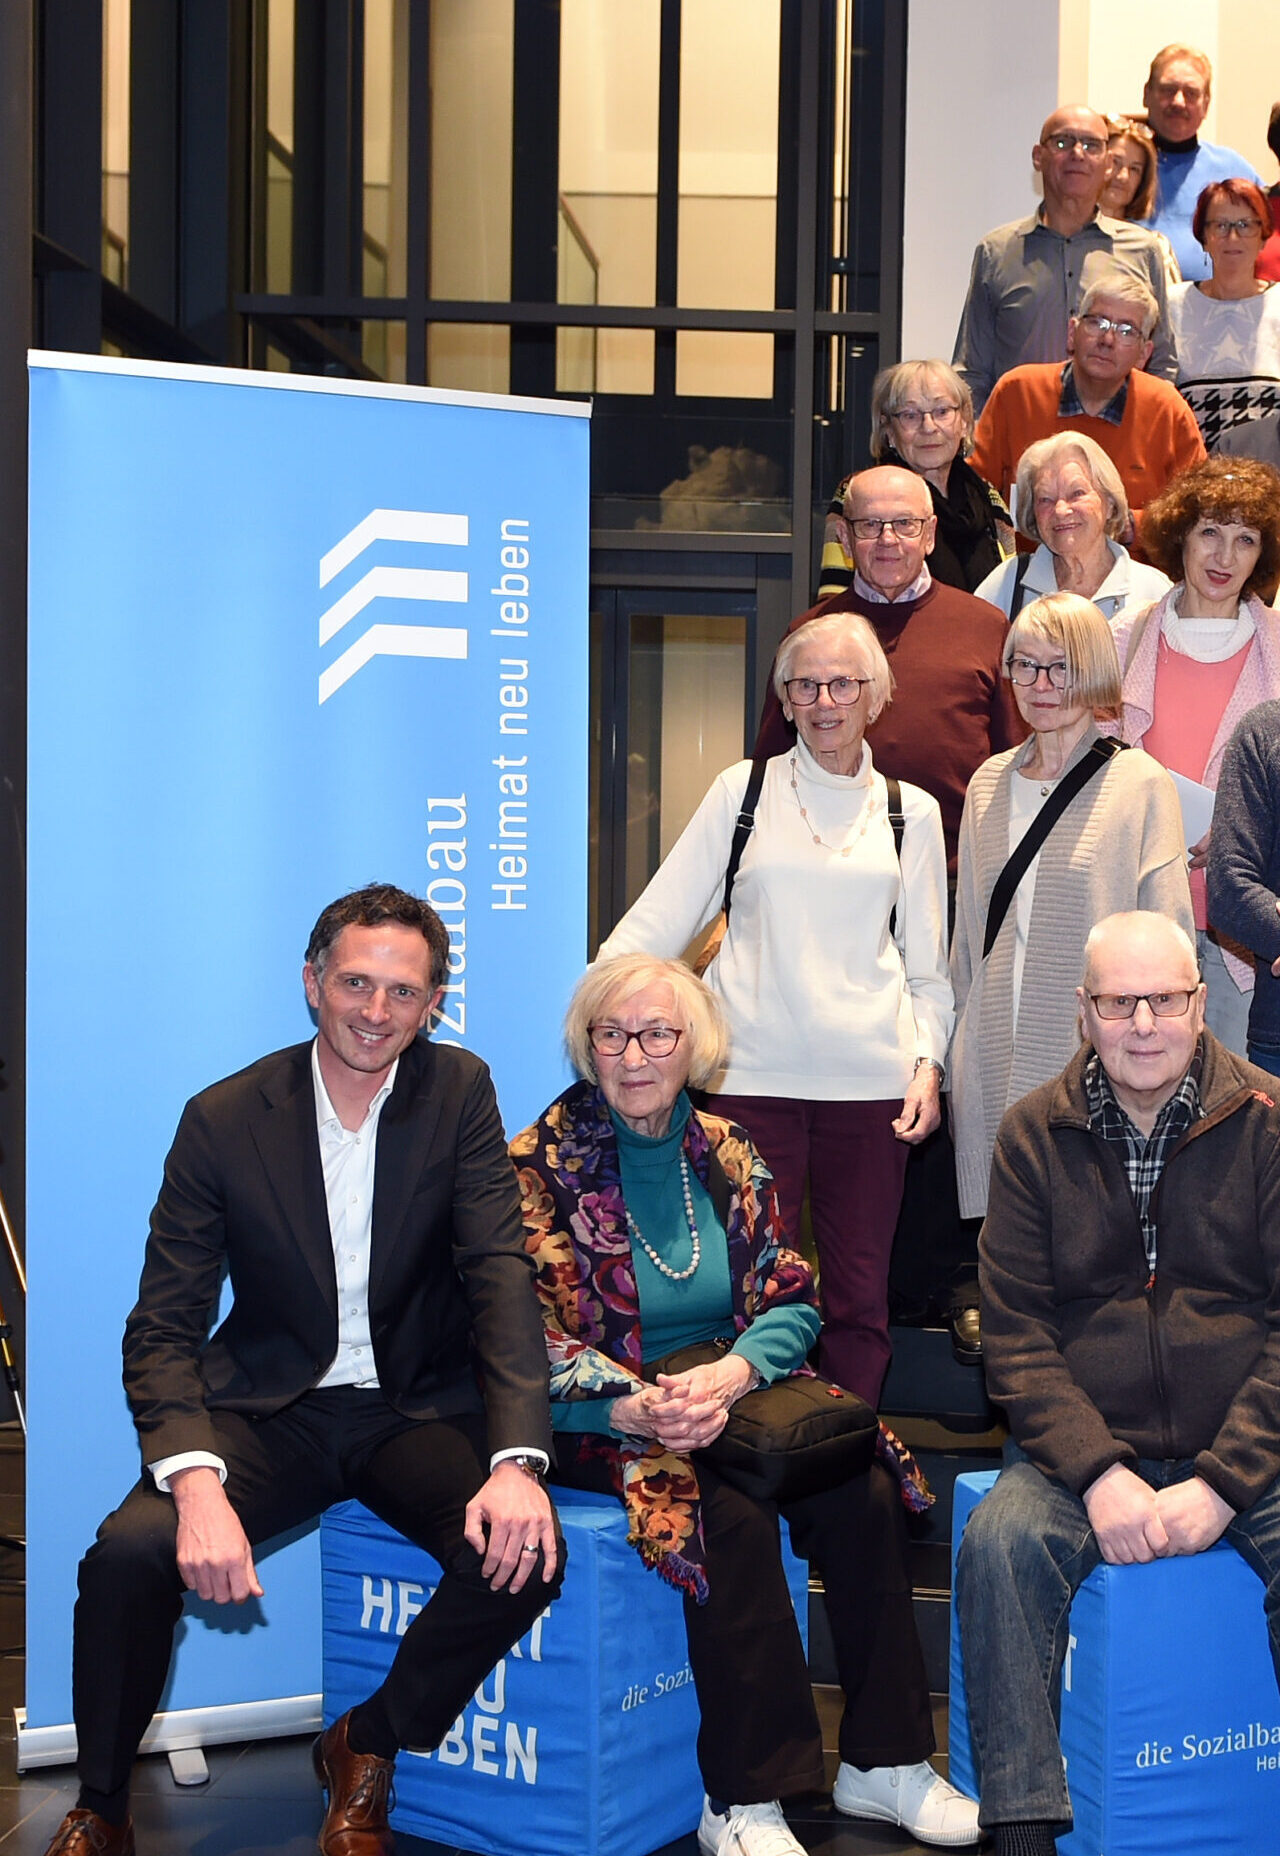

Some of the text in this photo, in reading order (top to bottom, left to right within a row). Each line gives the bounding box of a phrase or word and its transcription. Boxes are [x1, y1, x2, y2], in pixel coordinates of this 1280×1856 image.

[489, 519, 530, 910] Heimat neu leben
[622, 1684, 649, 1712] die
[1135, 1741, 1173, 1769] die
